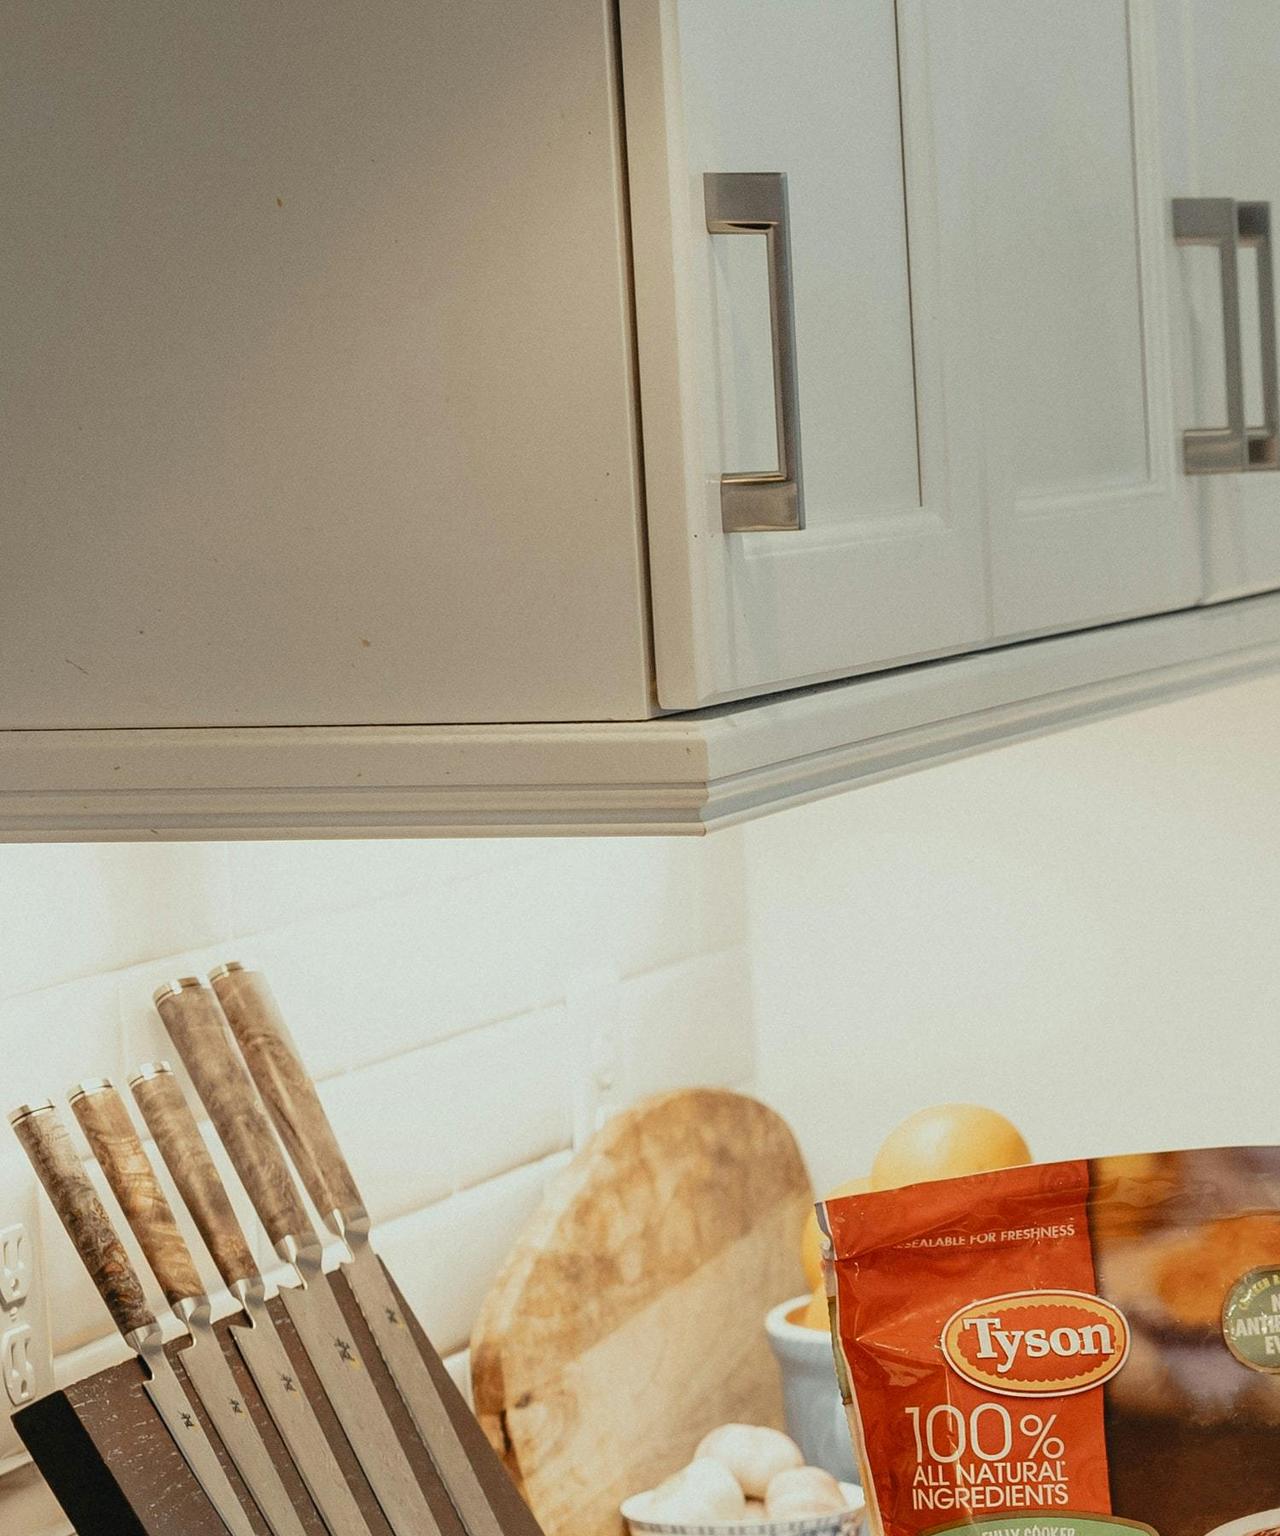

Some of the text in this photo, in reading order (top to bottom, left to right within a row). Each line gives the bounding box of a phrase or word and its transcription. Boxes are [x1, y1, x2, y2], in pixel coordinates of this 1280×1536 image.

[970, 1232, 996, 1244] FOR
[1000, 1224, 1075, 1242] FRESHNESS
[963, 1318, 1115, 1373] Tyson
[913, 1465, 950, 1487] ALL
[912, 1483, 1069, 1510] INGREDIENTS
